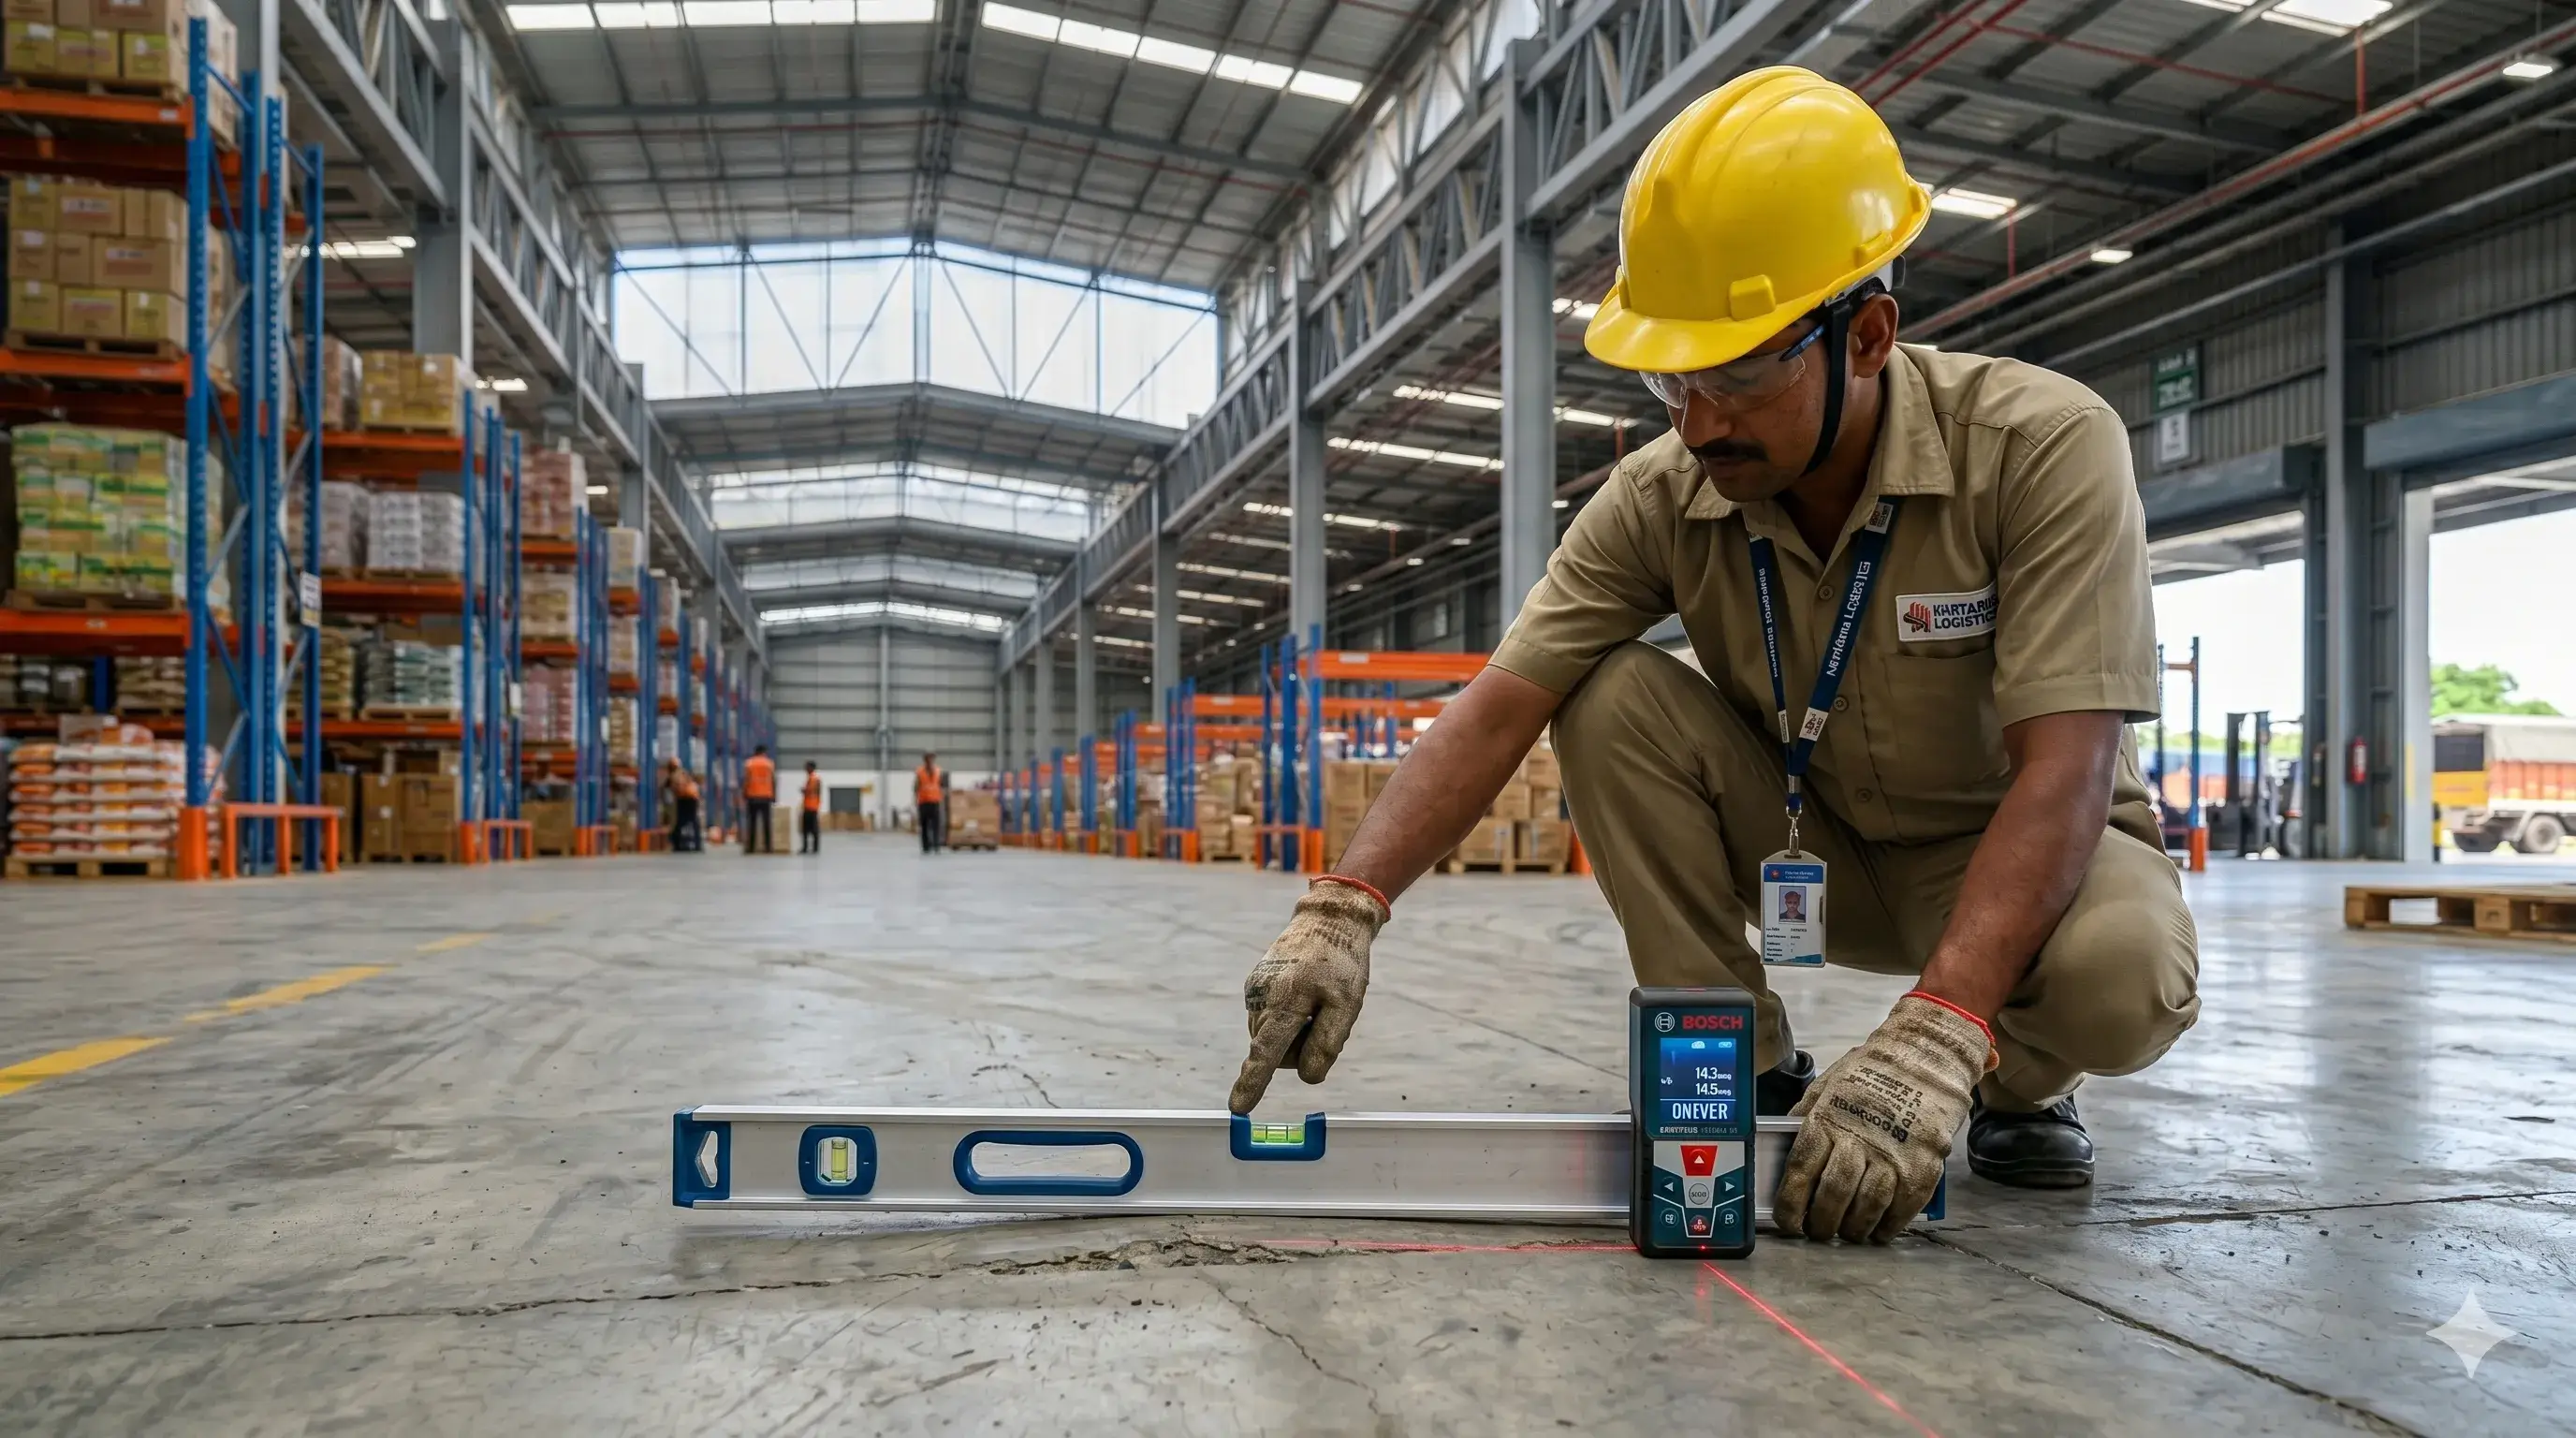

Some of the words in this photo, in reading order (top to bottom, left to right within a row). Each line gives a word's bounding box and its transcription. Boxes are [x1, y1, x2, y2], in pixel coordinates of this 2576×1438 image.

[1934, 609, 1997, 629] LOGISTIC
[1682, 1015, 1744, 1030] BOSCH
[1672, 1103, 1728, 1120] ONEVER
